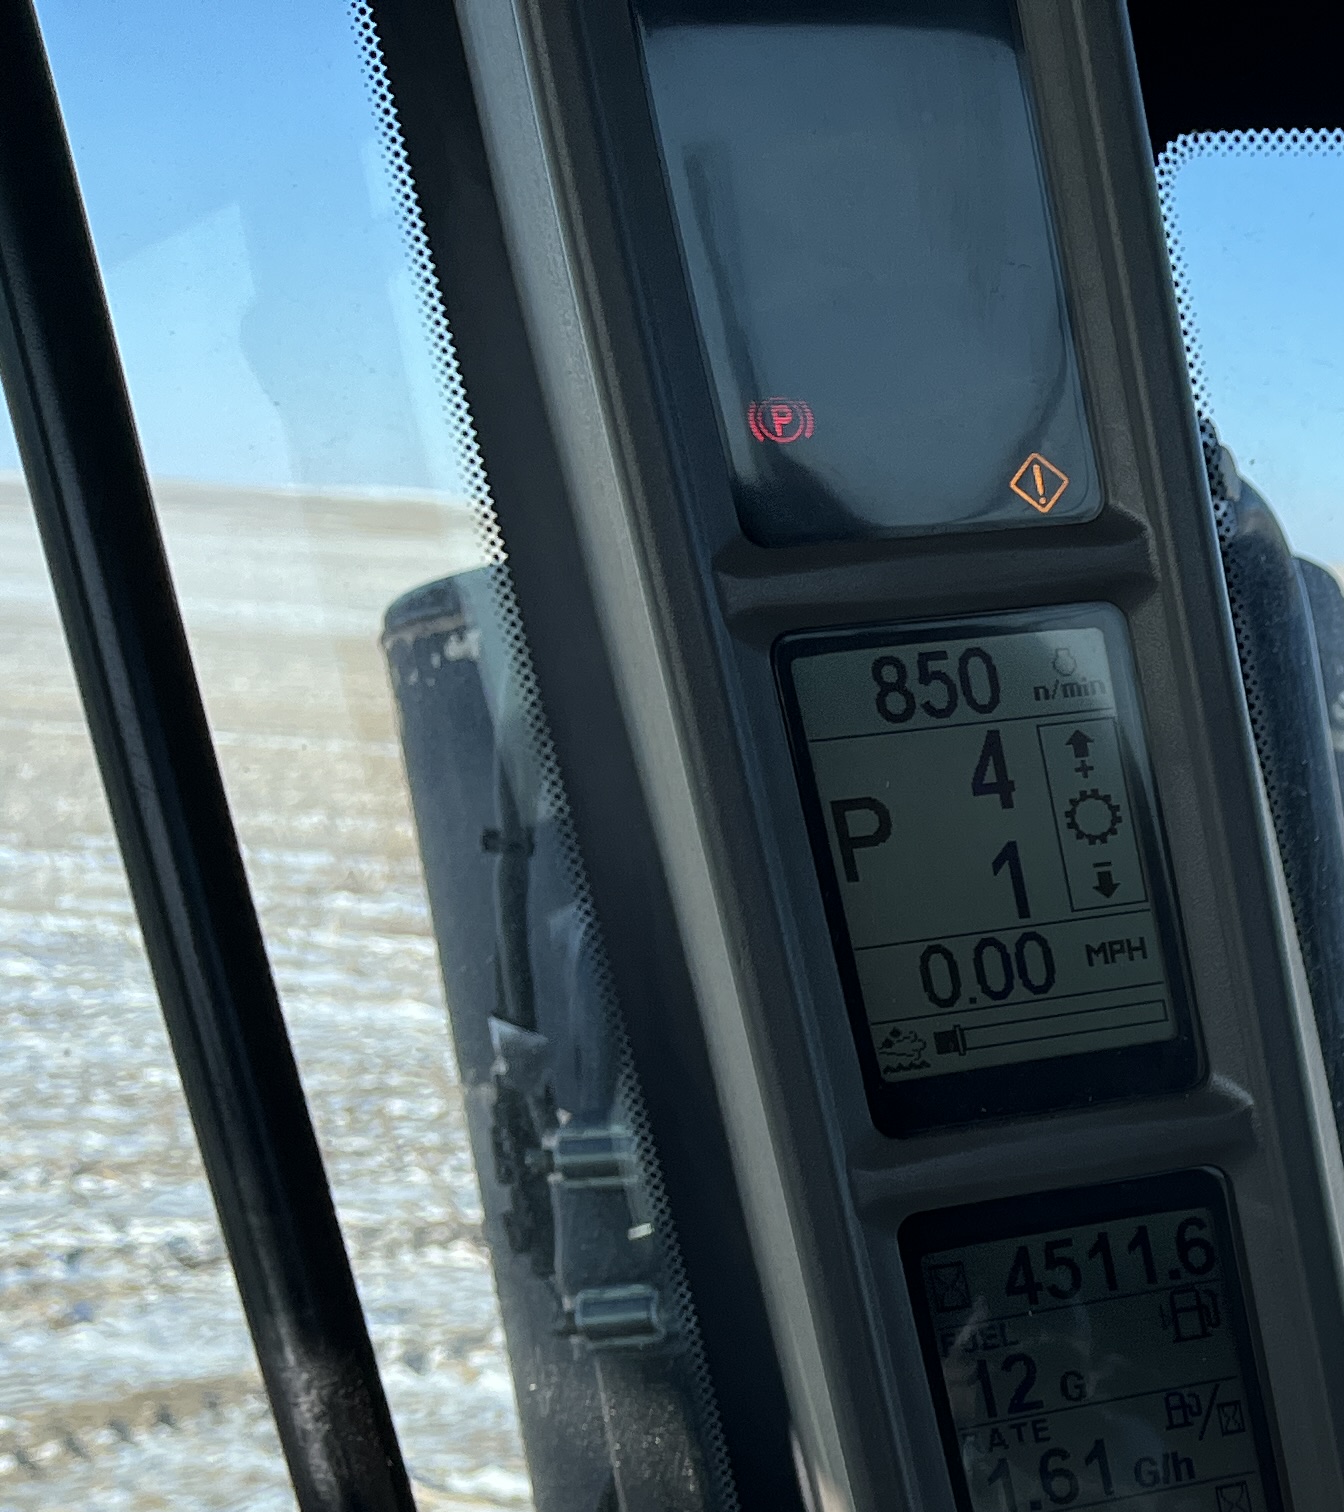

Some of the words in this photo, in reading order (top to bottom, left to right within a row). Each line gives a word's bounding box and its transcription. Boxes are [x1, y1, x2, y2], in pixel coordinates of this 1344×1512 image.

[872, 647, 1001, 723] 850
[1033, 677, 1107, 702] n/min
[971, 729, 1016, 810] 4
[829, 797, 892, 882] P
[991, 840, 1030, 919] 1
[919, 931, 1056, 1009] 0.00
[1085, 937, 1148, 967] MPH
[1005, 1215, 1215, 1305] 4511.6
[940, 1322, 1020, 1358] FUEL
[966, 1352, 1045, 1418] 12
[1060, 1369, 1087, 1402] G
[1134, 1451, 1196, 1488] G/h
